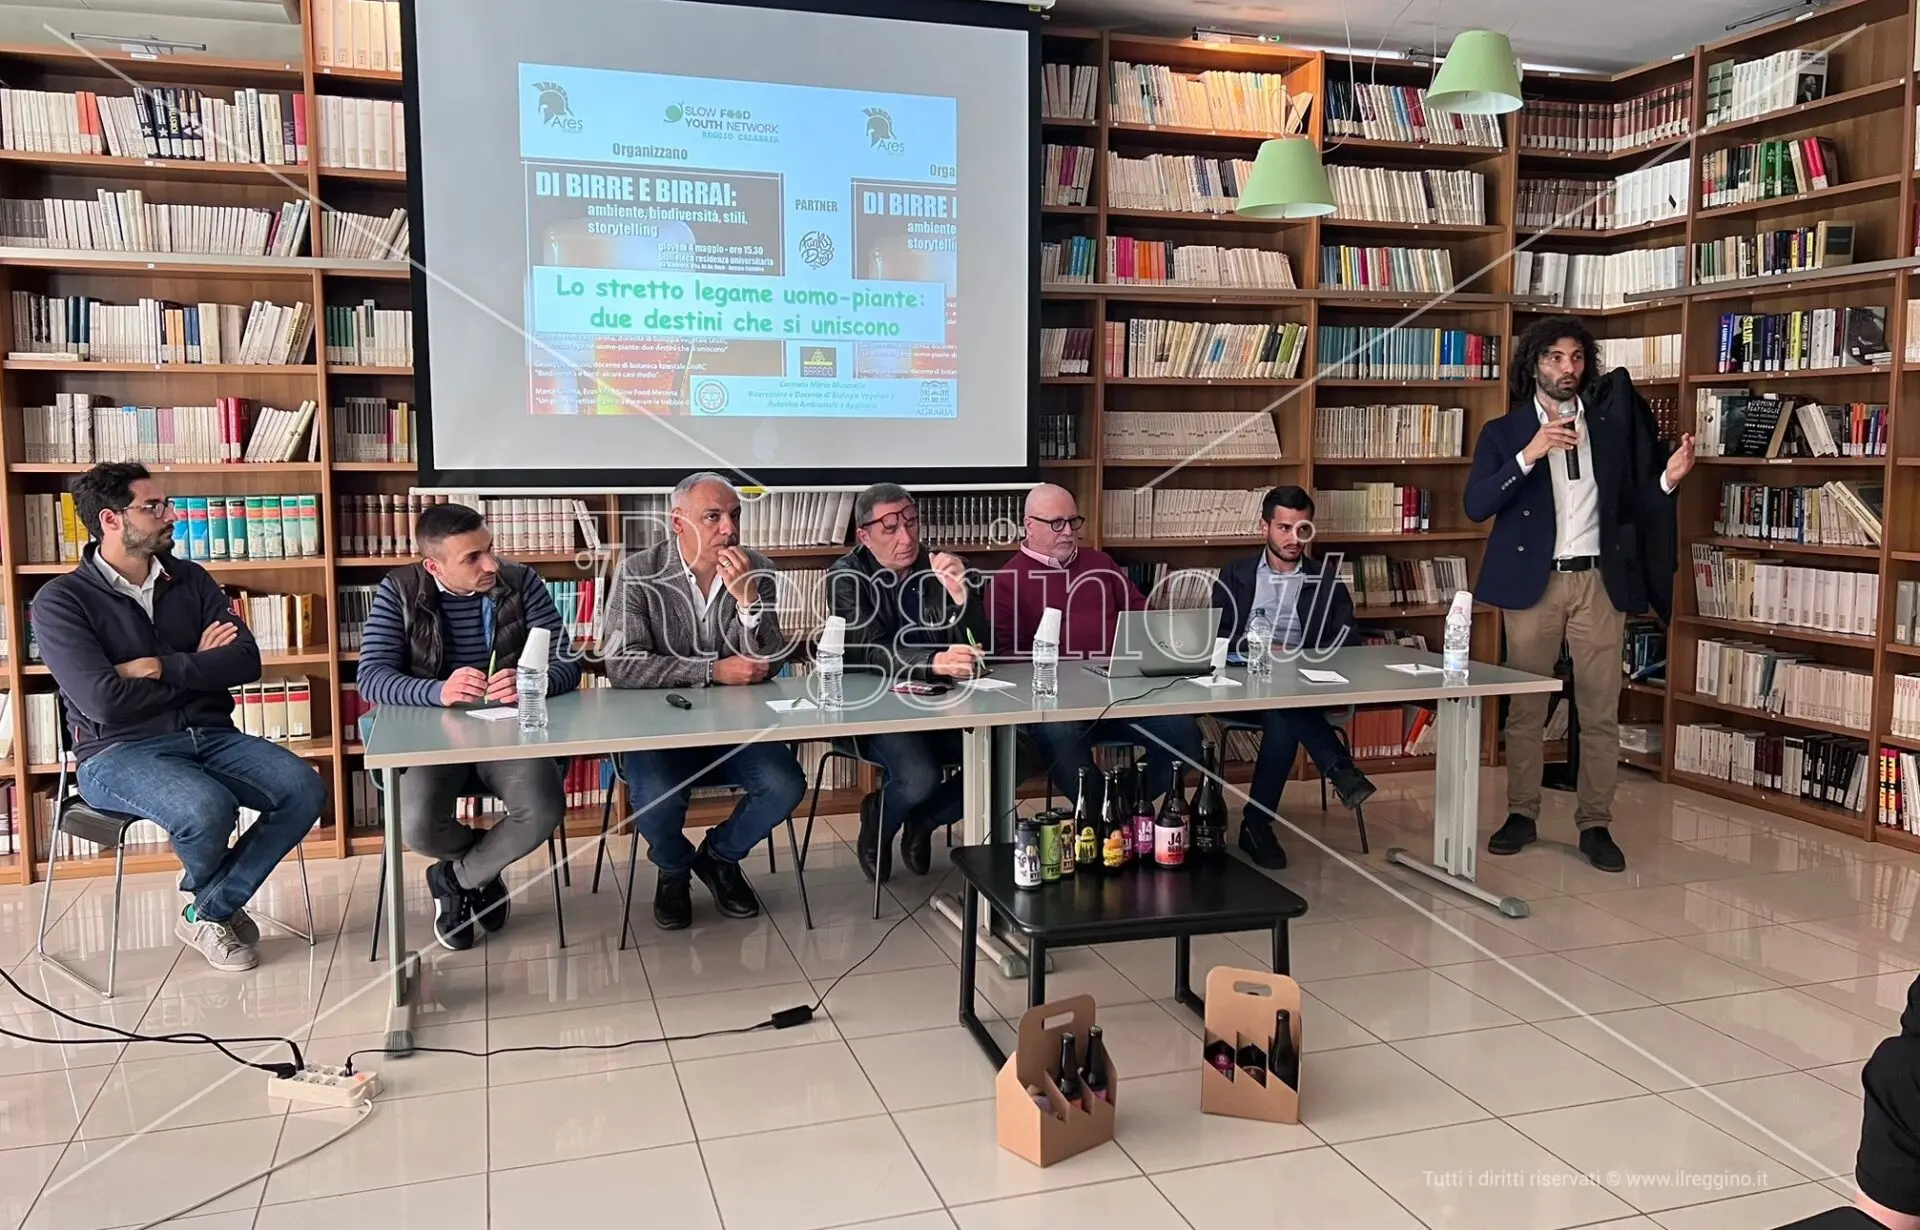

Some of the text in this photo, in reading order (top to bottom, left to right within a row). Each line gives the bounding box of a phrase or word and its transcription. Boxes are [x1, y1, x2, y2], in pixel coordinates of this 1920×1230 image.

[684, 105, 751, 120] SLOW FOOD
[551, 115, 584, 130] Ares
[685, 118, 780, 134] YOUTH NETWORK
[612, 142, 688, 160] Organizzano
[877, 138, 905, 153] Ares
[535, 171, 737, 207] DI BIRRE E BIRRAI:
[795, 199, 838, 212] PARTNER
[863, 191, 948, 219] DI BIRRE
[587, 204, 749, 225] ambiente, biodiversità, stili,
[587, 222, 659, 238] storytelling
[695, 244, 724, 254] maggio
[556, 274, 925, 313] Lo stretto legame uomo-piante:
[590, 306, 900, 337] due destini che si uniscono
[1168, 831, 1182, 846] J4
